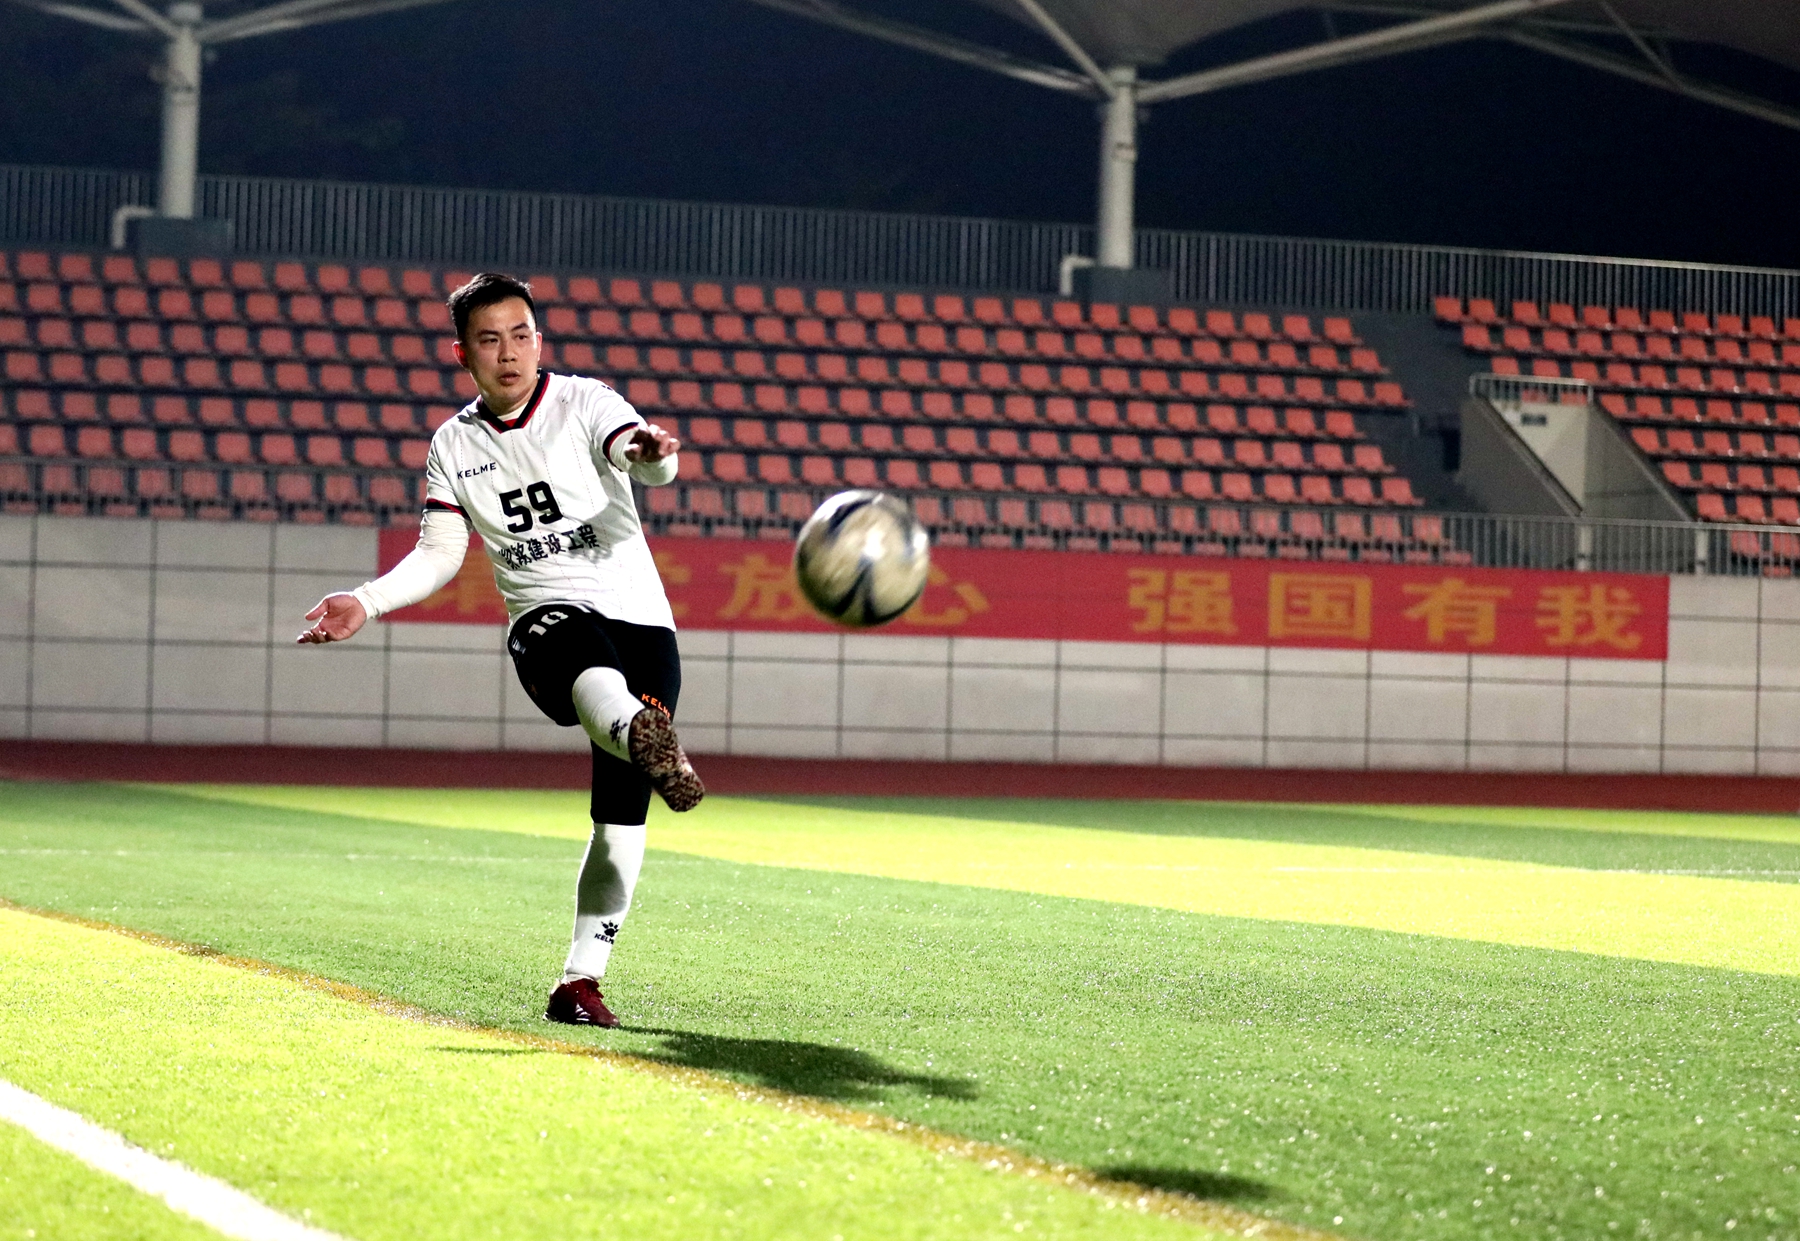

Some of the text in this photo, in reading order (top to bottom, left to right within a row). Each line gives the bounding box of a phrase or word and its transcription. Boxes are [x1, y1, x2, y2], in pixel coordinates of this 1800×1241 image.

[456, 462, 497, 480] KELME
[499, 480, 563, 534] 59
[1126, 567, 1644, 651] 强国有我
[528, 611, 569, 636] 10
[594, 933, 615, 945] KELM
